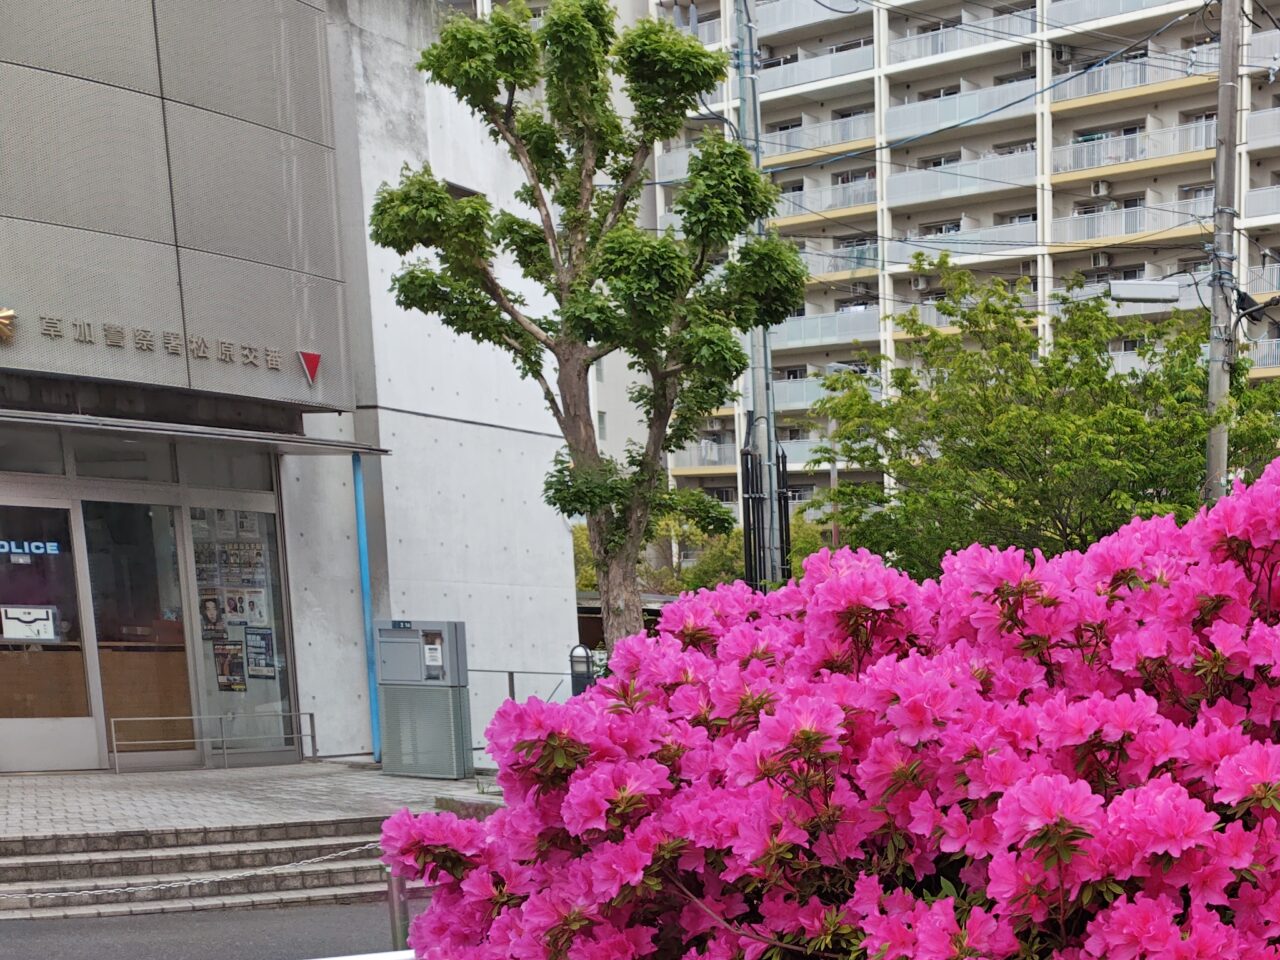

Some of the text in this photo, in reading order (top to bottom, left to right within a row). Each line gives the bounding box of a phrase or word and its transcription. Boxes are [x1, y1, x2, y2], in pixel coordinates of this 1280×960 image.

[39, 315, 282, 371] 草加警察署松原交番
